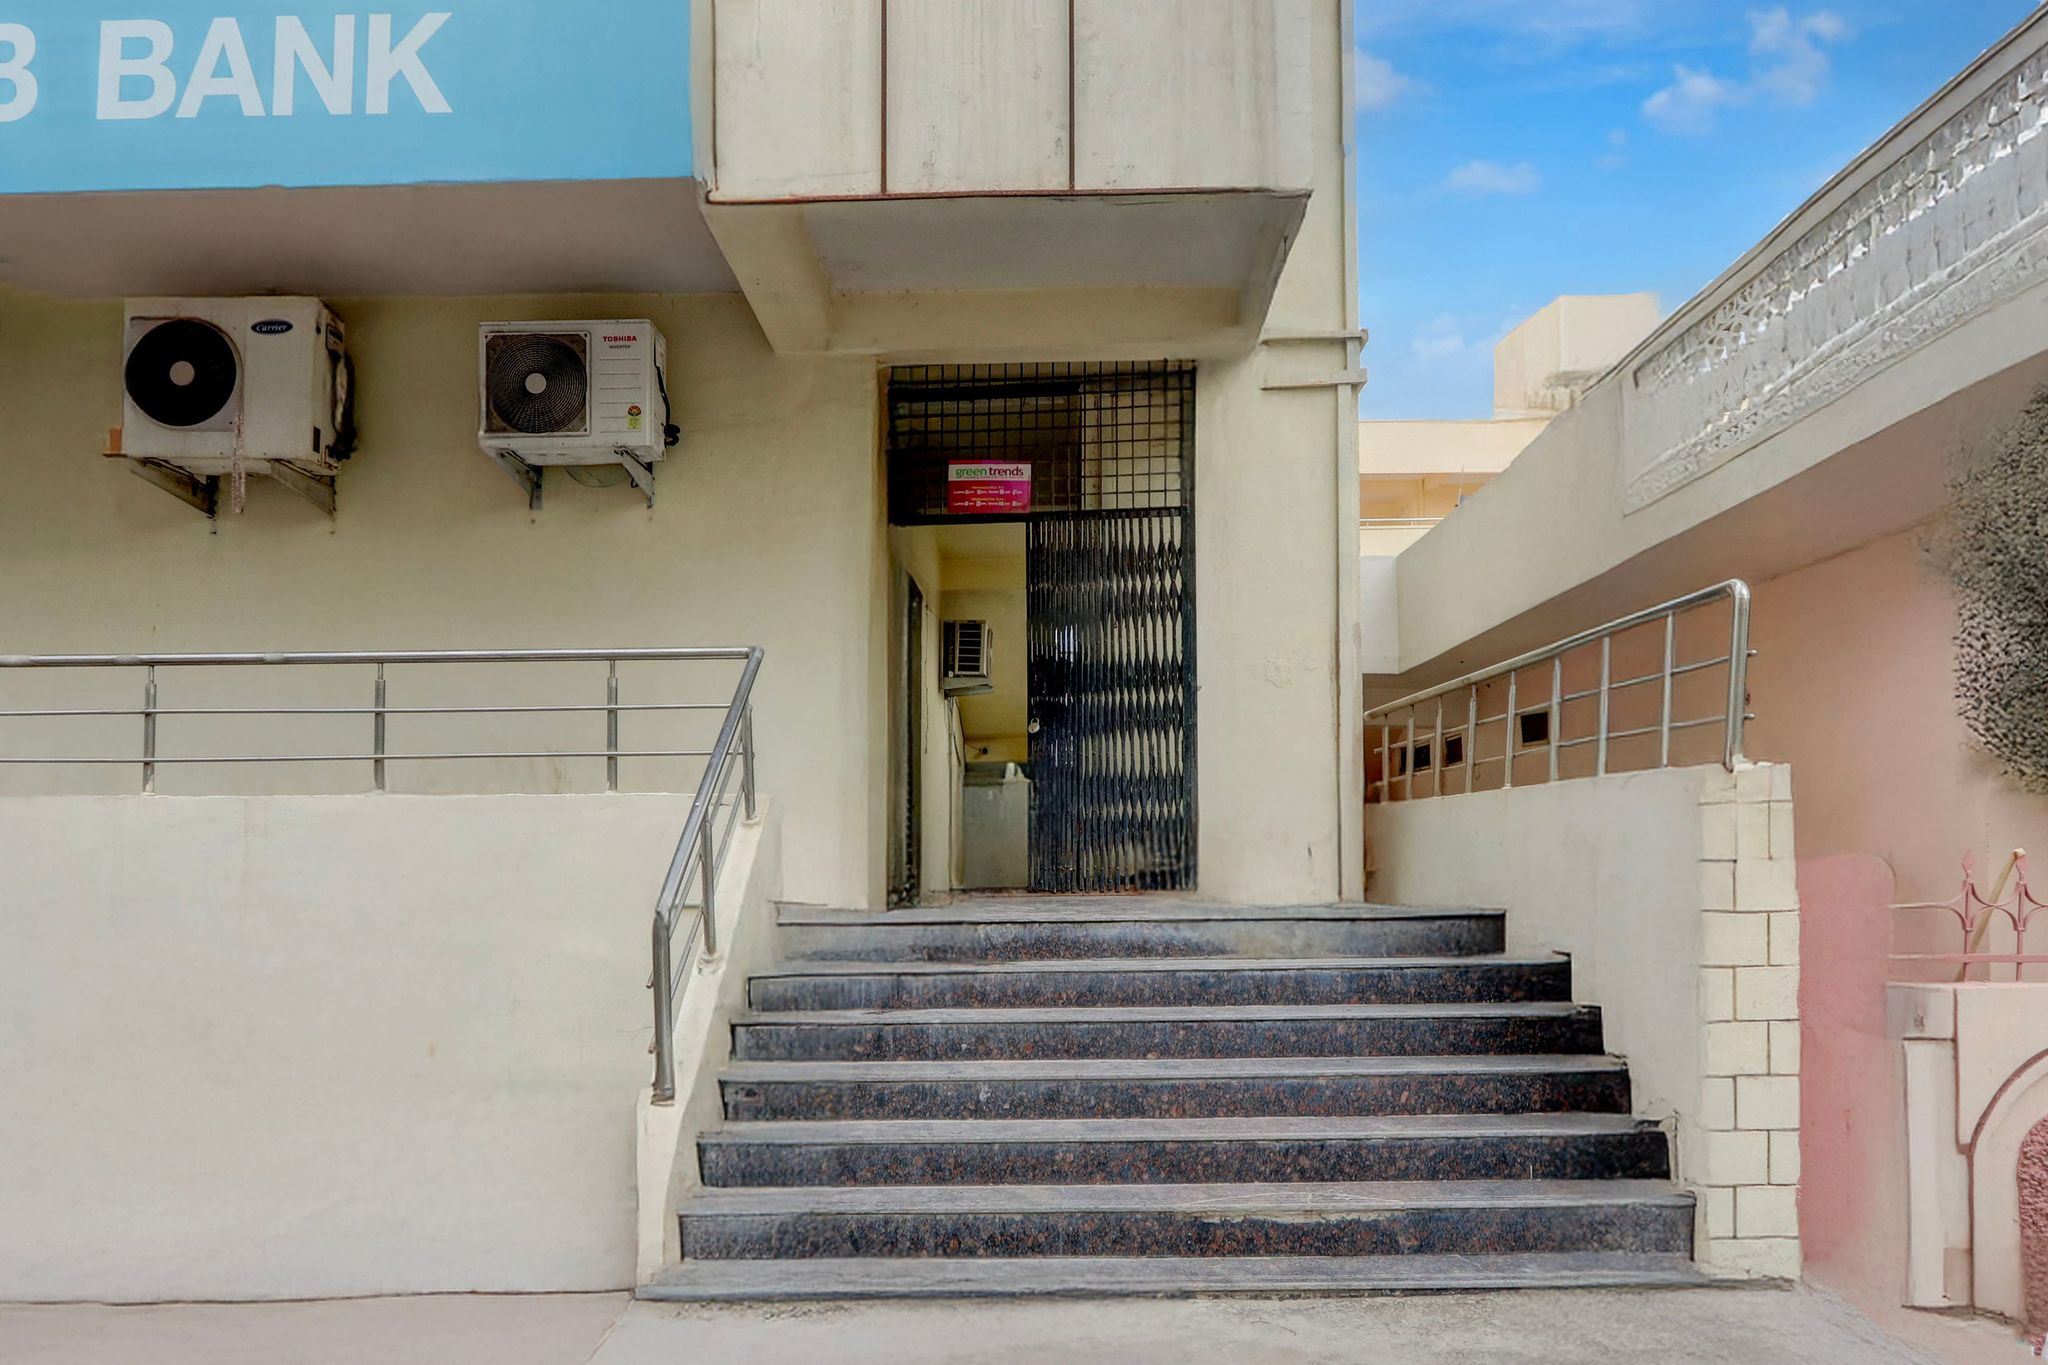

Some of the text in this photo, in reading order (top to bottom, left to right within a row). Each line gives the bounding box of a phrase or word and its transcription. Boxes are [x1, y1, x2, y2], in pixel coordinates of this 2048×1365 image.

[96, 12, 453, 120] BANK
[256, 324, 288, 332] Carrier
[956, 466, 1024, 479] green trends
